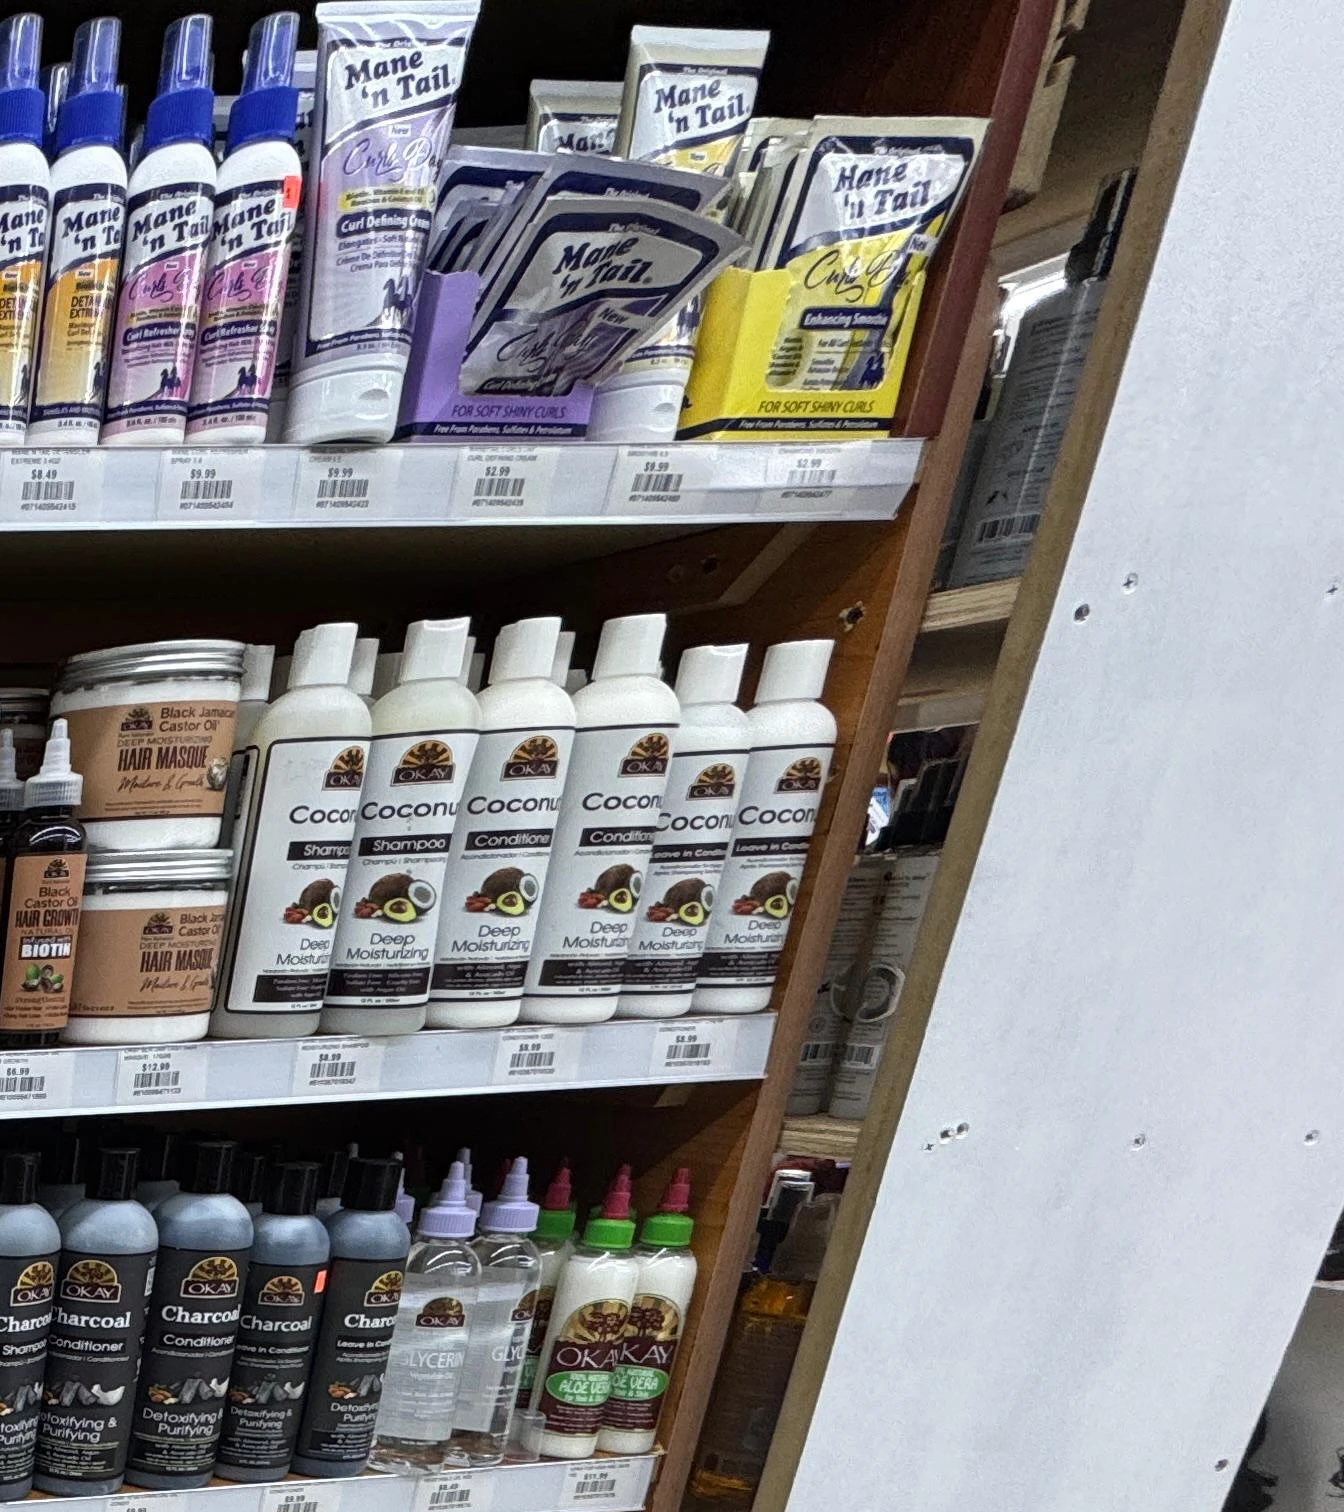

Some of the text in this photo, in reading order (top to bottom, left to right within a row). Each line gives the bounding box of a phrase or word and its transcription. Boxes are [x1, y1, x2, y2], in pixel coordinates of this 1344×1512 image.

[344, 50, 424, 90] Mane
[654, 80, 722, 112] Mane
[834, 162, 907, 194] Mane
[452, 402, 566, 419] FOR SOFT SHINY CURLS
[758, 399, 873, 414] FOR SOFT SHINY CURLS
[31, 469, 58, 480] $8.49
[190, 468, 216, 479] $9.99
[485, 466, 510, 476] $2.99
[118, 746, 208, 771] HAIR MASQUE
[399, 765, 451, 783] OKAY
[374, 836, 446, 852] Shampoo
[370, 934, 415, 948] Deep
[21, 942, 70, 958] BIOTIN
[346, 946, 428, 962] Moisturizing
[187, 1282, 234, 1295] OKAY
[163, 1306, 241, 1323] Charcoal
[420, 1317, 460, 1326] OKAY
[164, 1336, 234, 1347] Conditioner
[159, 1424, 213, 1436] Purifying
